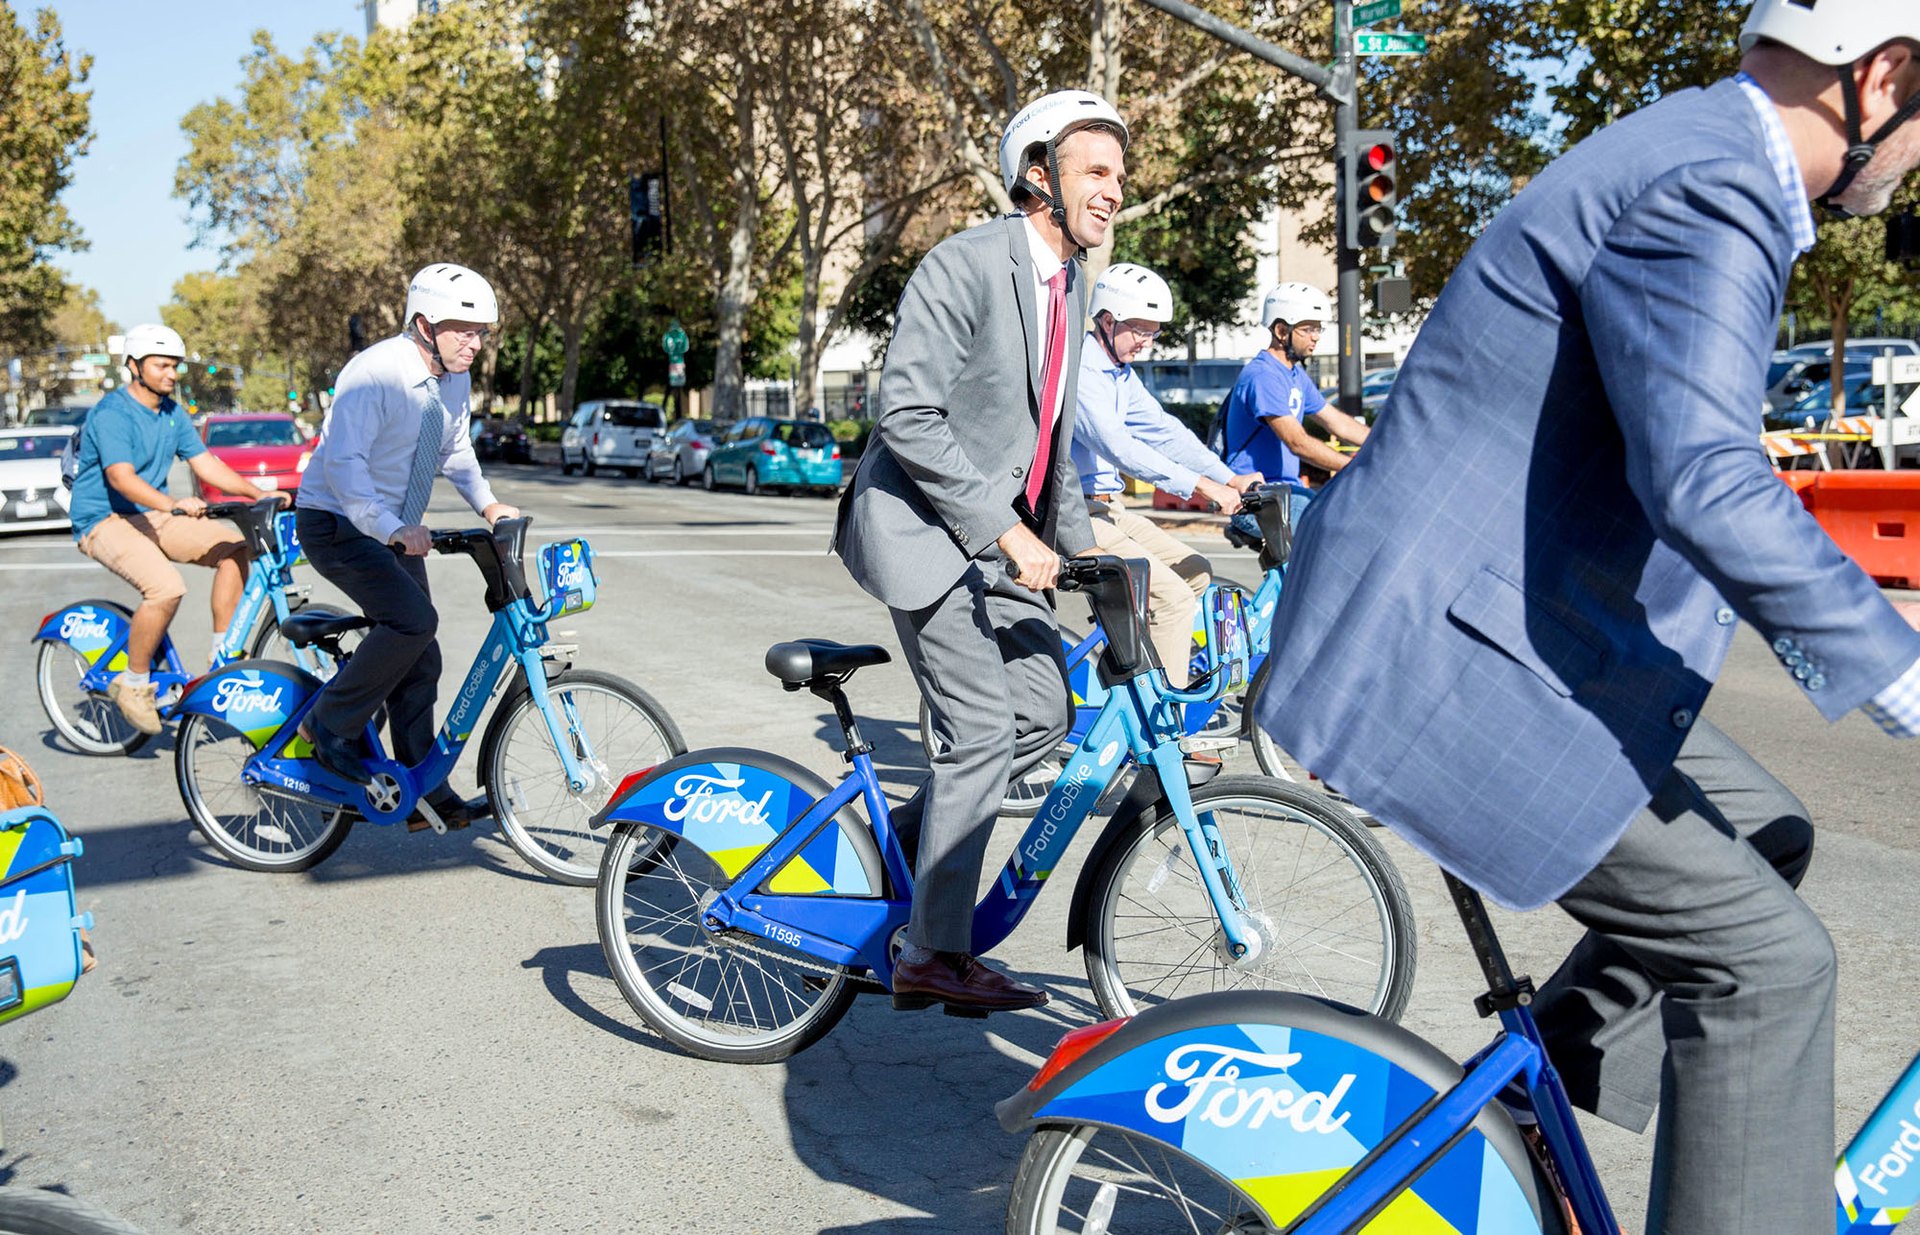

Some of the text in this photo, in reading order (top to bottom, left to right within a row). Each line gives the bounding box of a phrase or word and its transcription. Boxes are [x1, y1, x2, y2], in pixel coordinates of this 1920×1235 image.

[557, 562, 584, 588] Ford
[60, 612, 110, 639] Ford
[212, 678, 283, 712] Ford
[451, 660, 489, 726] Ford GoBike
[663, 775, 774, 825] Ford
[1025, 764, 1092, 861] Ford GoBike
[764, 923, 802, 947] 11595
[1144, 1043, 1357, 1134] Ford
